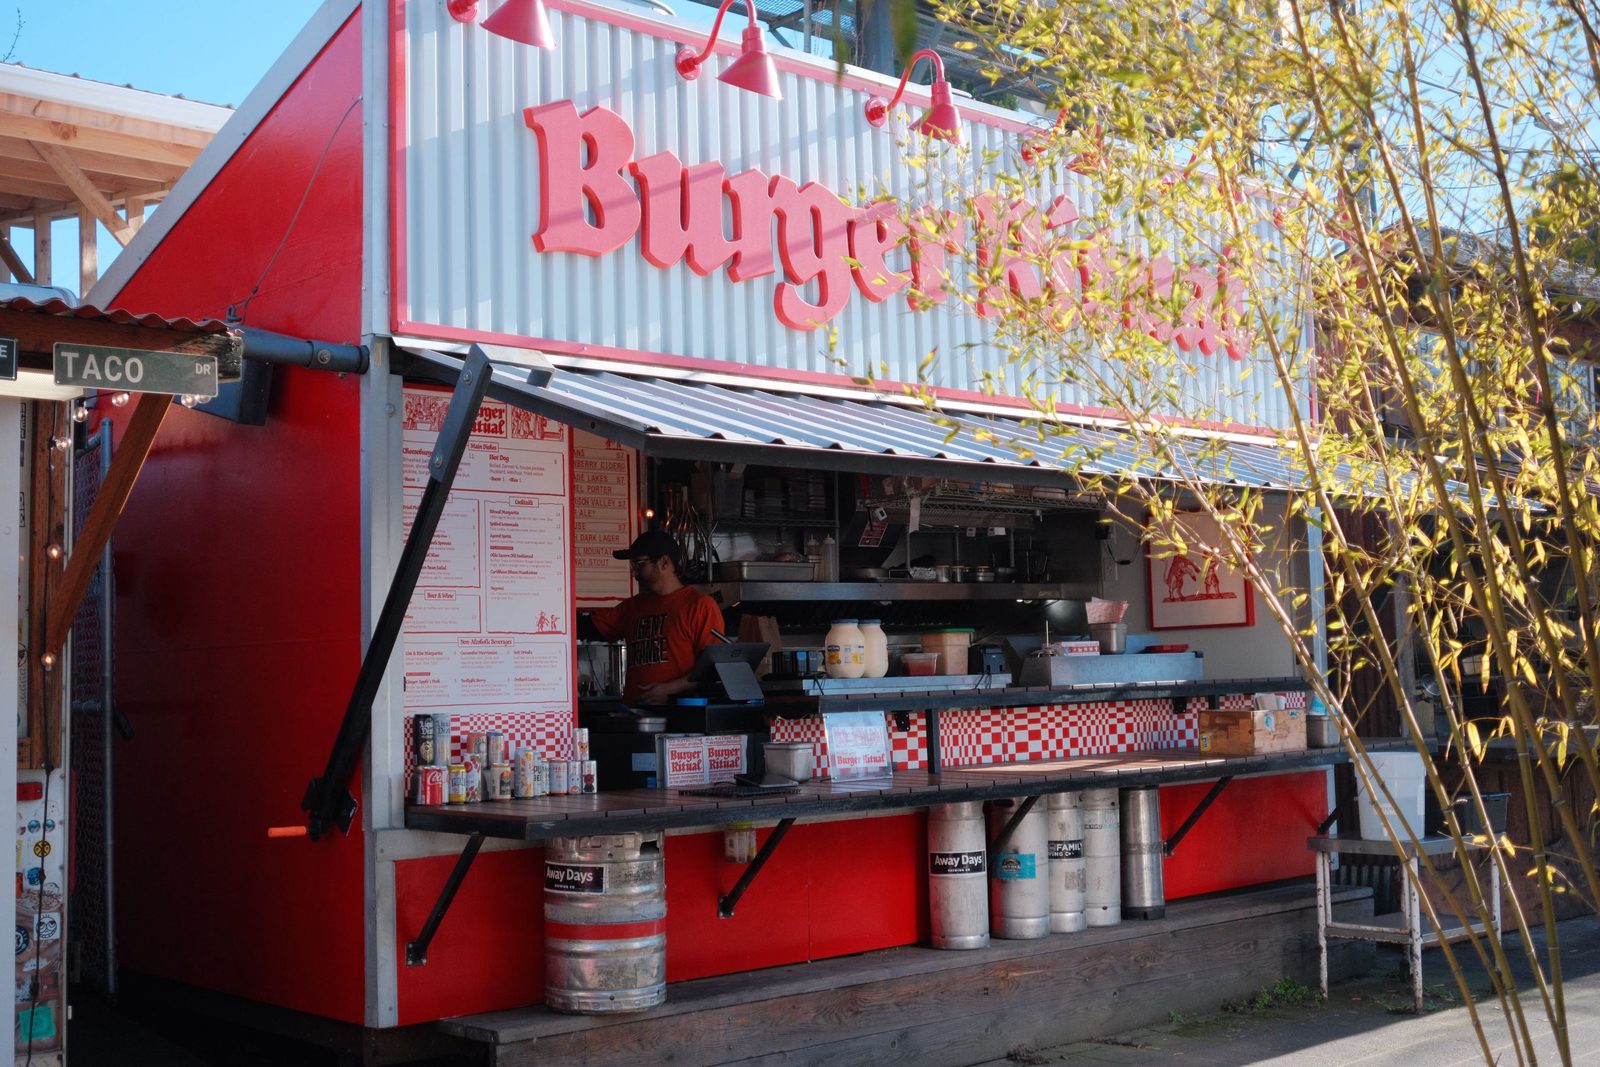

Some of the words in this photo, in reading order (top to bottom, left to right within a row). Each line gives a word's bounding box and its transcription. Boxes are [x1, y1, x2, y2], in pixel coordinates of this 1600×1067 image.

[524, 99, 964, 331] Burger
[61, 351, 144, 383] TACO
[195, 362, 211, 376] DR
[478, 407, 505, 421] rger
[472, 419, 505, 434] itual
[500, 455, 509, 463] Dog
[588, 485, 612, 494] PORTER
[580, 534, 596, 542] DARK
[670, 750, 701, 762] Burger
[708, 747, 740, 760] Burger
[671, 759, 702, 772] Ritual
[709, 756, 740, 770] Ritual
[935, 855, 960, 868] Away
[961, 855, 982, 867] Days
[546, 865, 565, 882] Away
[566, 868, 593, 884] Days
